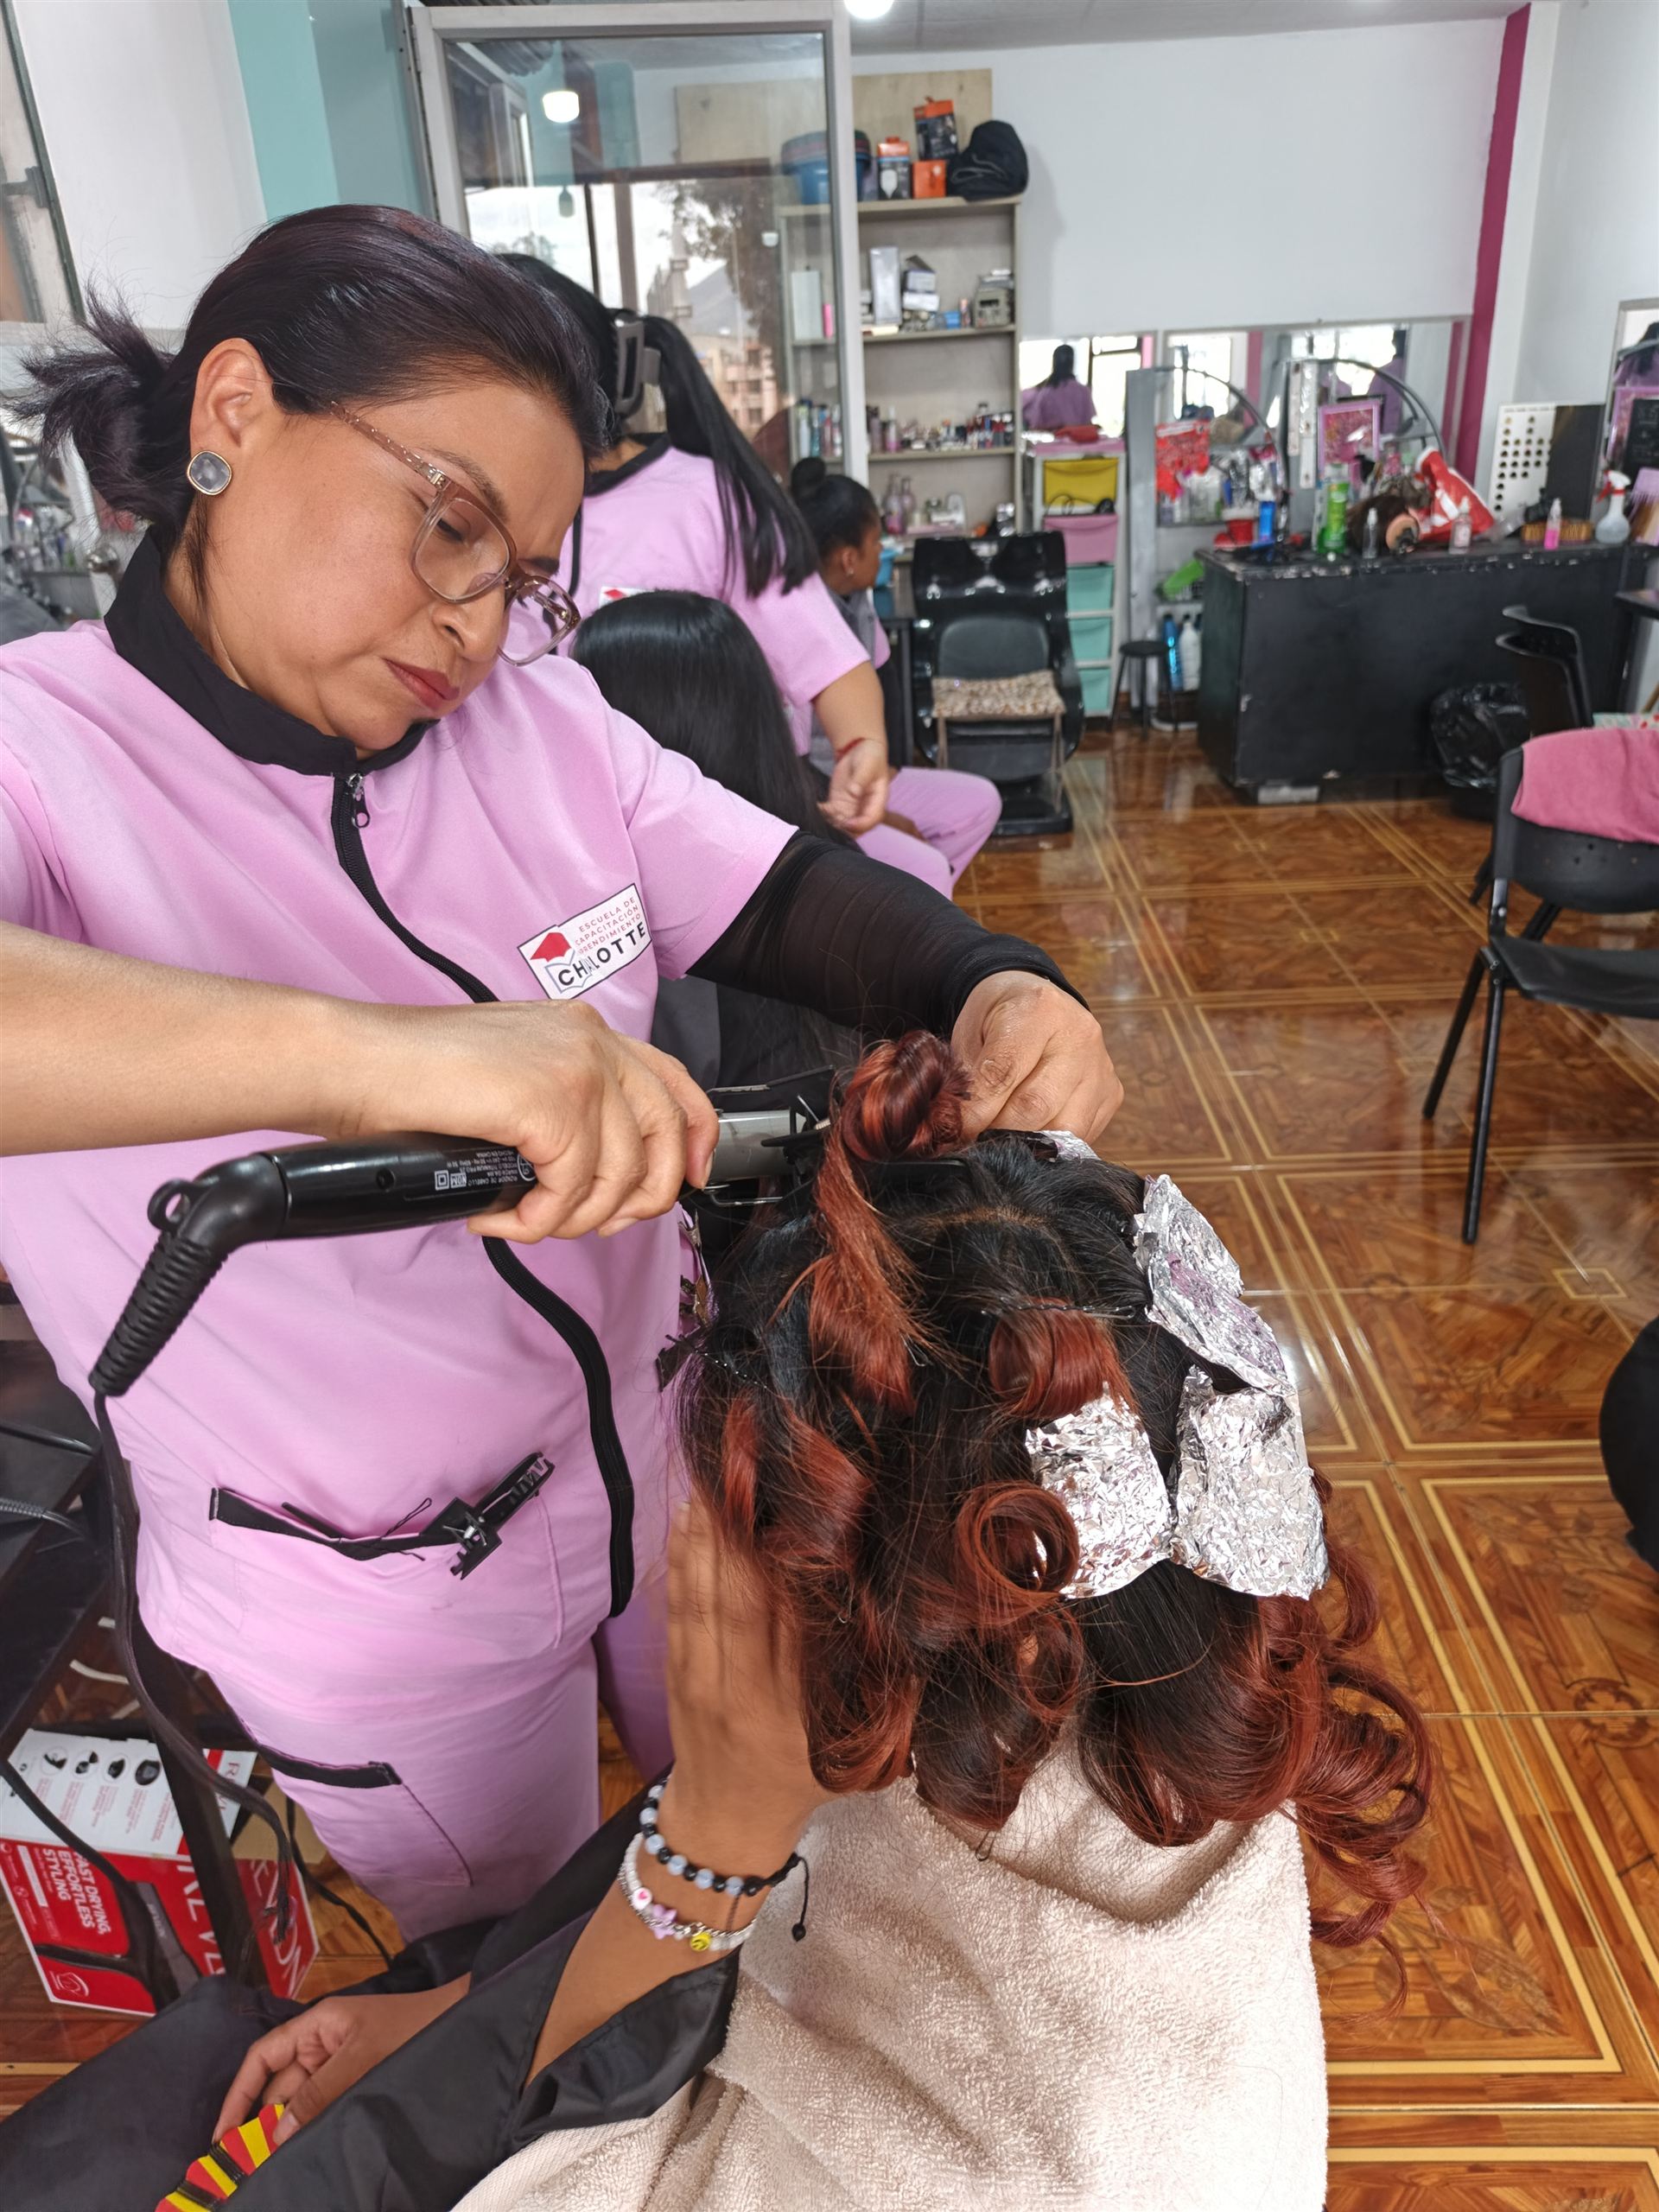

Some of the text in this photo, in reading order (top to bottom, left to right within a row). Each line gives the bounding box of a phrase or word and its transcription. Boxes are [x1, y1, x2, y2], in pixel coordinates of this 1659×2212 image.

[575, 905, 639, 946] CAPACITACIÓN
[579, 897, 635, 933] ESCUELA DE
[43, 1848, 72, 1901] STYLING
[58, 1850, 96, 1929] EFFORTLESS
